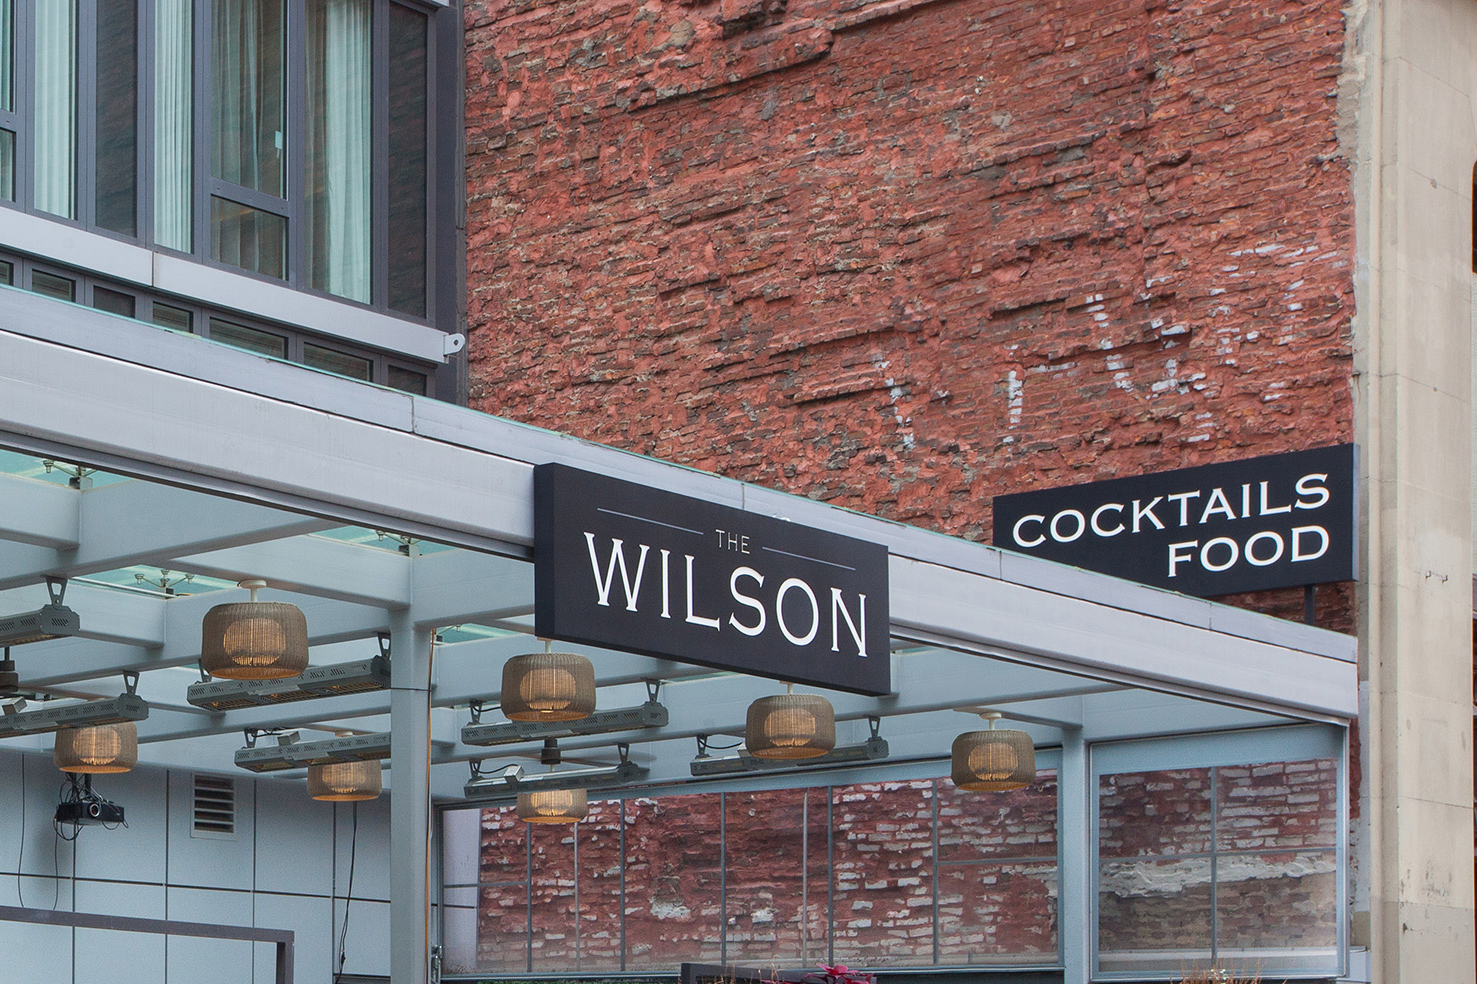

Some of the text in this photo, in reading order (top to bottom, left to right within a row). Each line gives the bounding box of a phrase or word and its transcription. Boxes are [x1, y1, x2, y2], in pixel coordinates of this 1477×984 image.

[715, 528, 752, 555] THE
[1013, 474, 1330, 548] COCKTAILS
[1168, 526, 1330, 578] FOOD
[584, 532, 868, 658] WILSON
